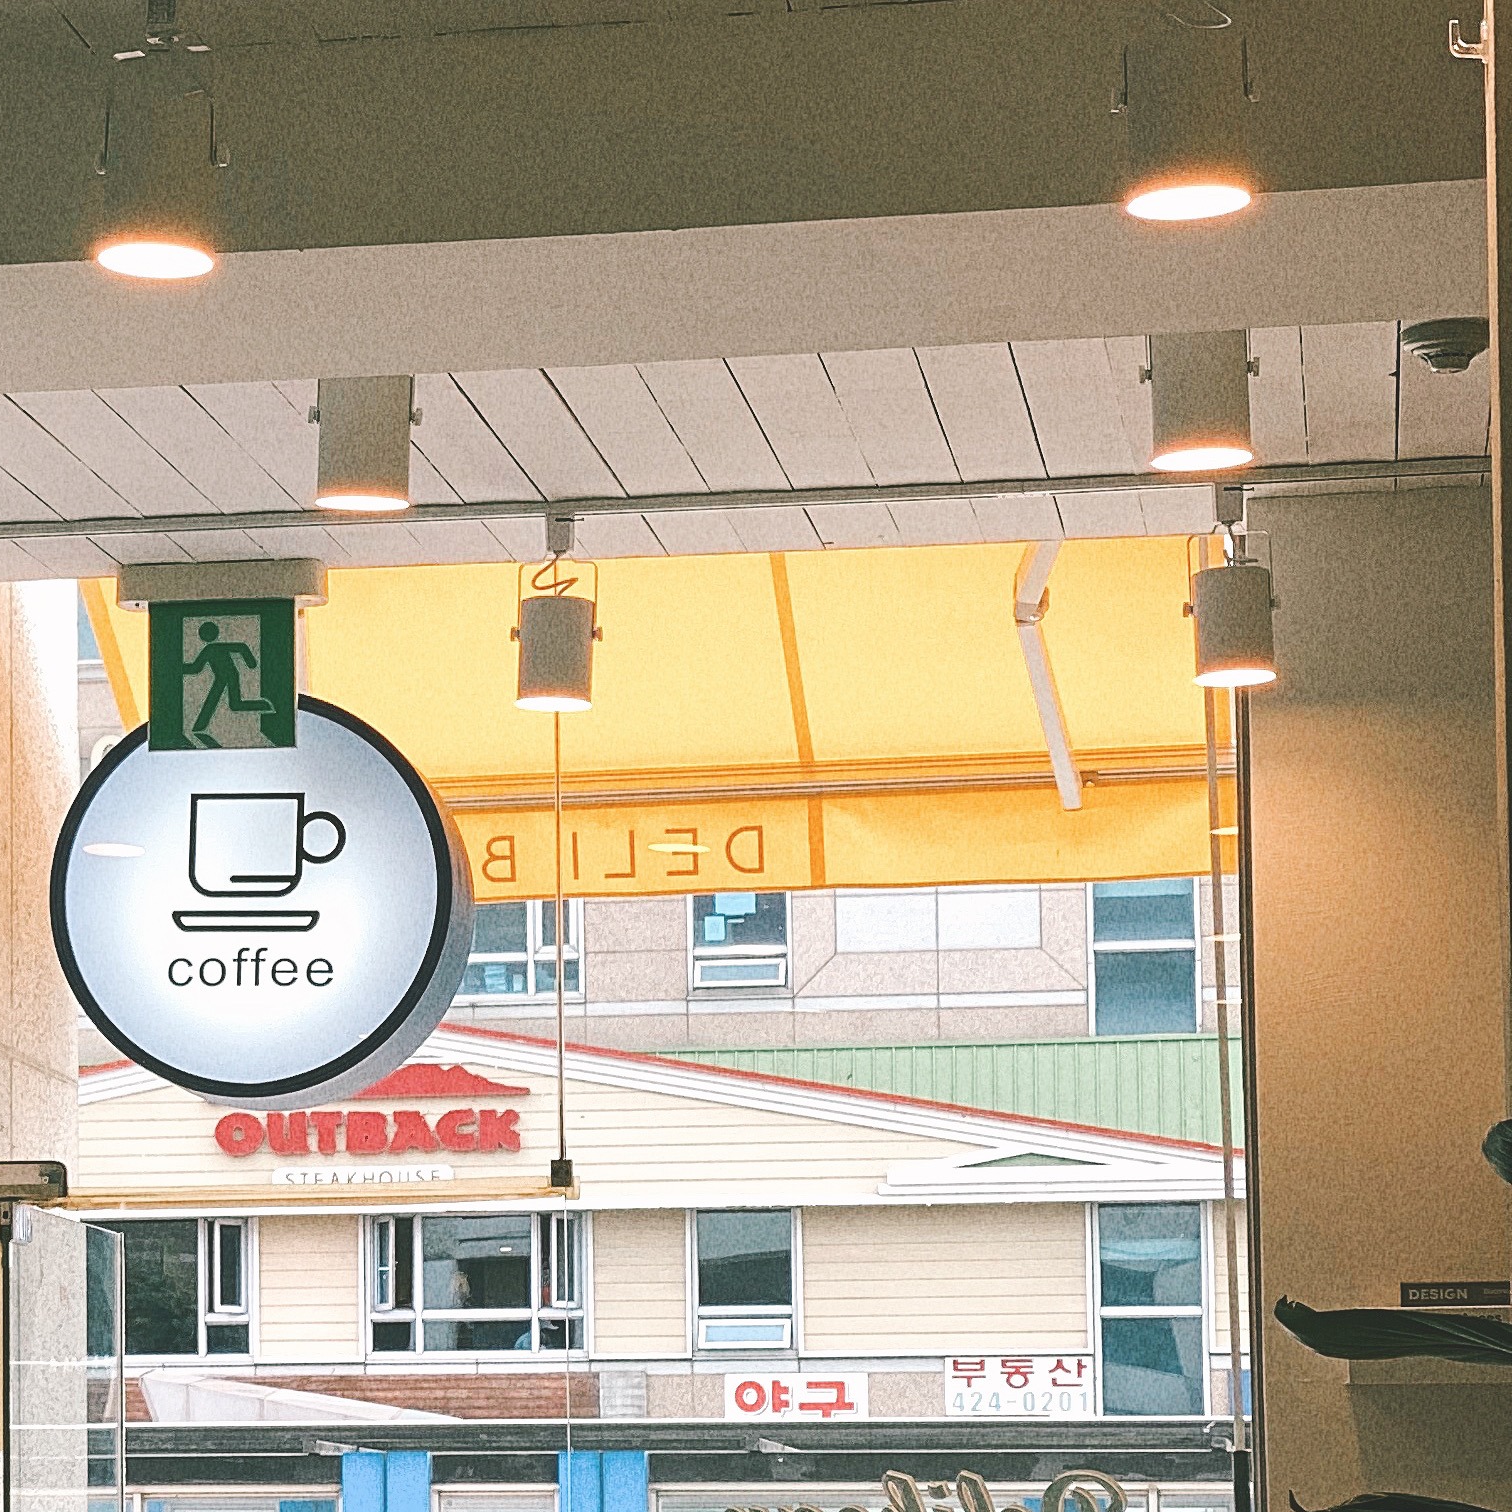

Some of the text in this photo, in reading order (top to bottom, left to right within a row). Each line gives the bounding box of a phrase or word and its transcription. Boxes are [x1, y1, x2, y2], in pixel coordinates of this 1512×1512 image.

[167, 946, 335, 987] coffee
[214, 1108, 521, 1157] OUTBACK
[1408, 1288, 1468, 1301] DESIGN
[951, 1358, 1088, 1389] 부동산
[733, 1379, 856, 1418] 야구
[952, 1391, 1088, 1412] 424-0201
